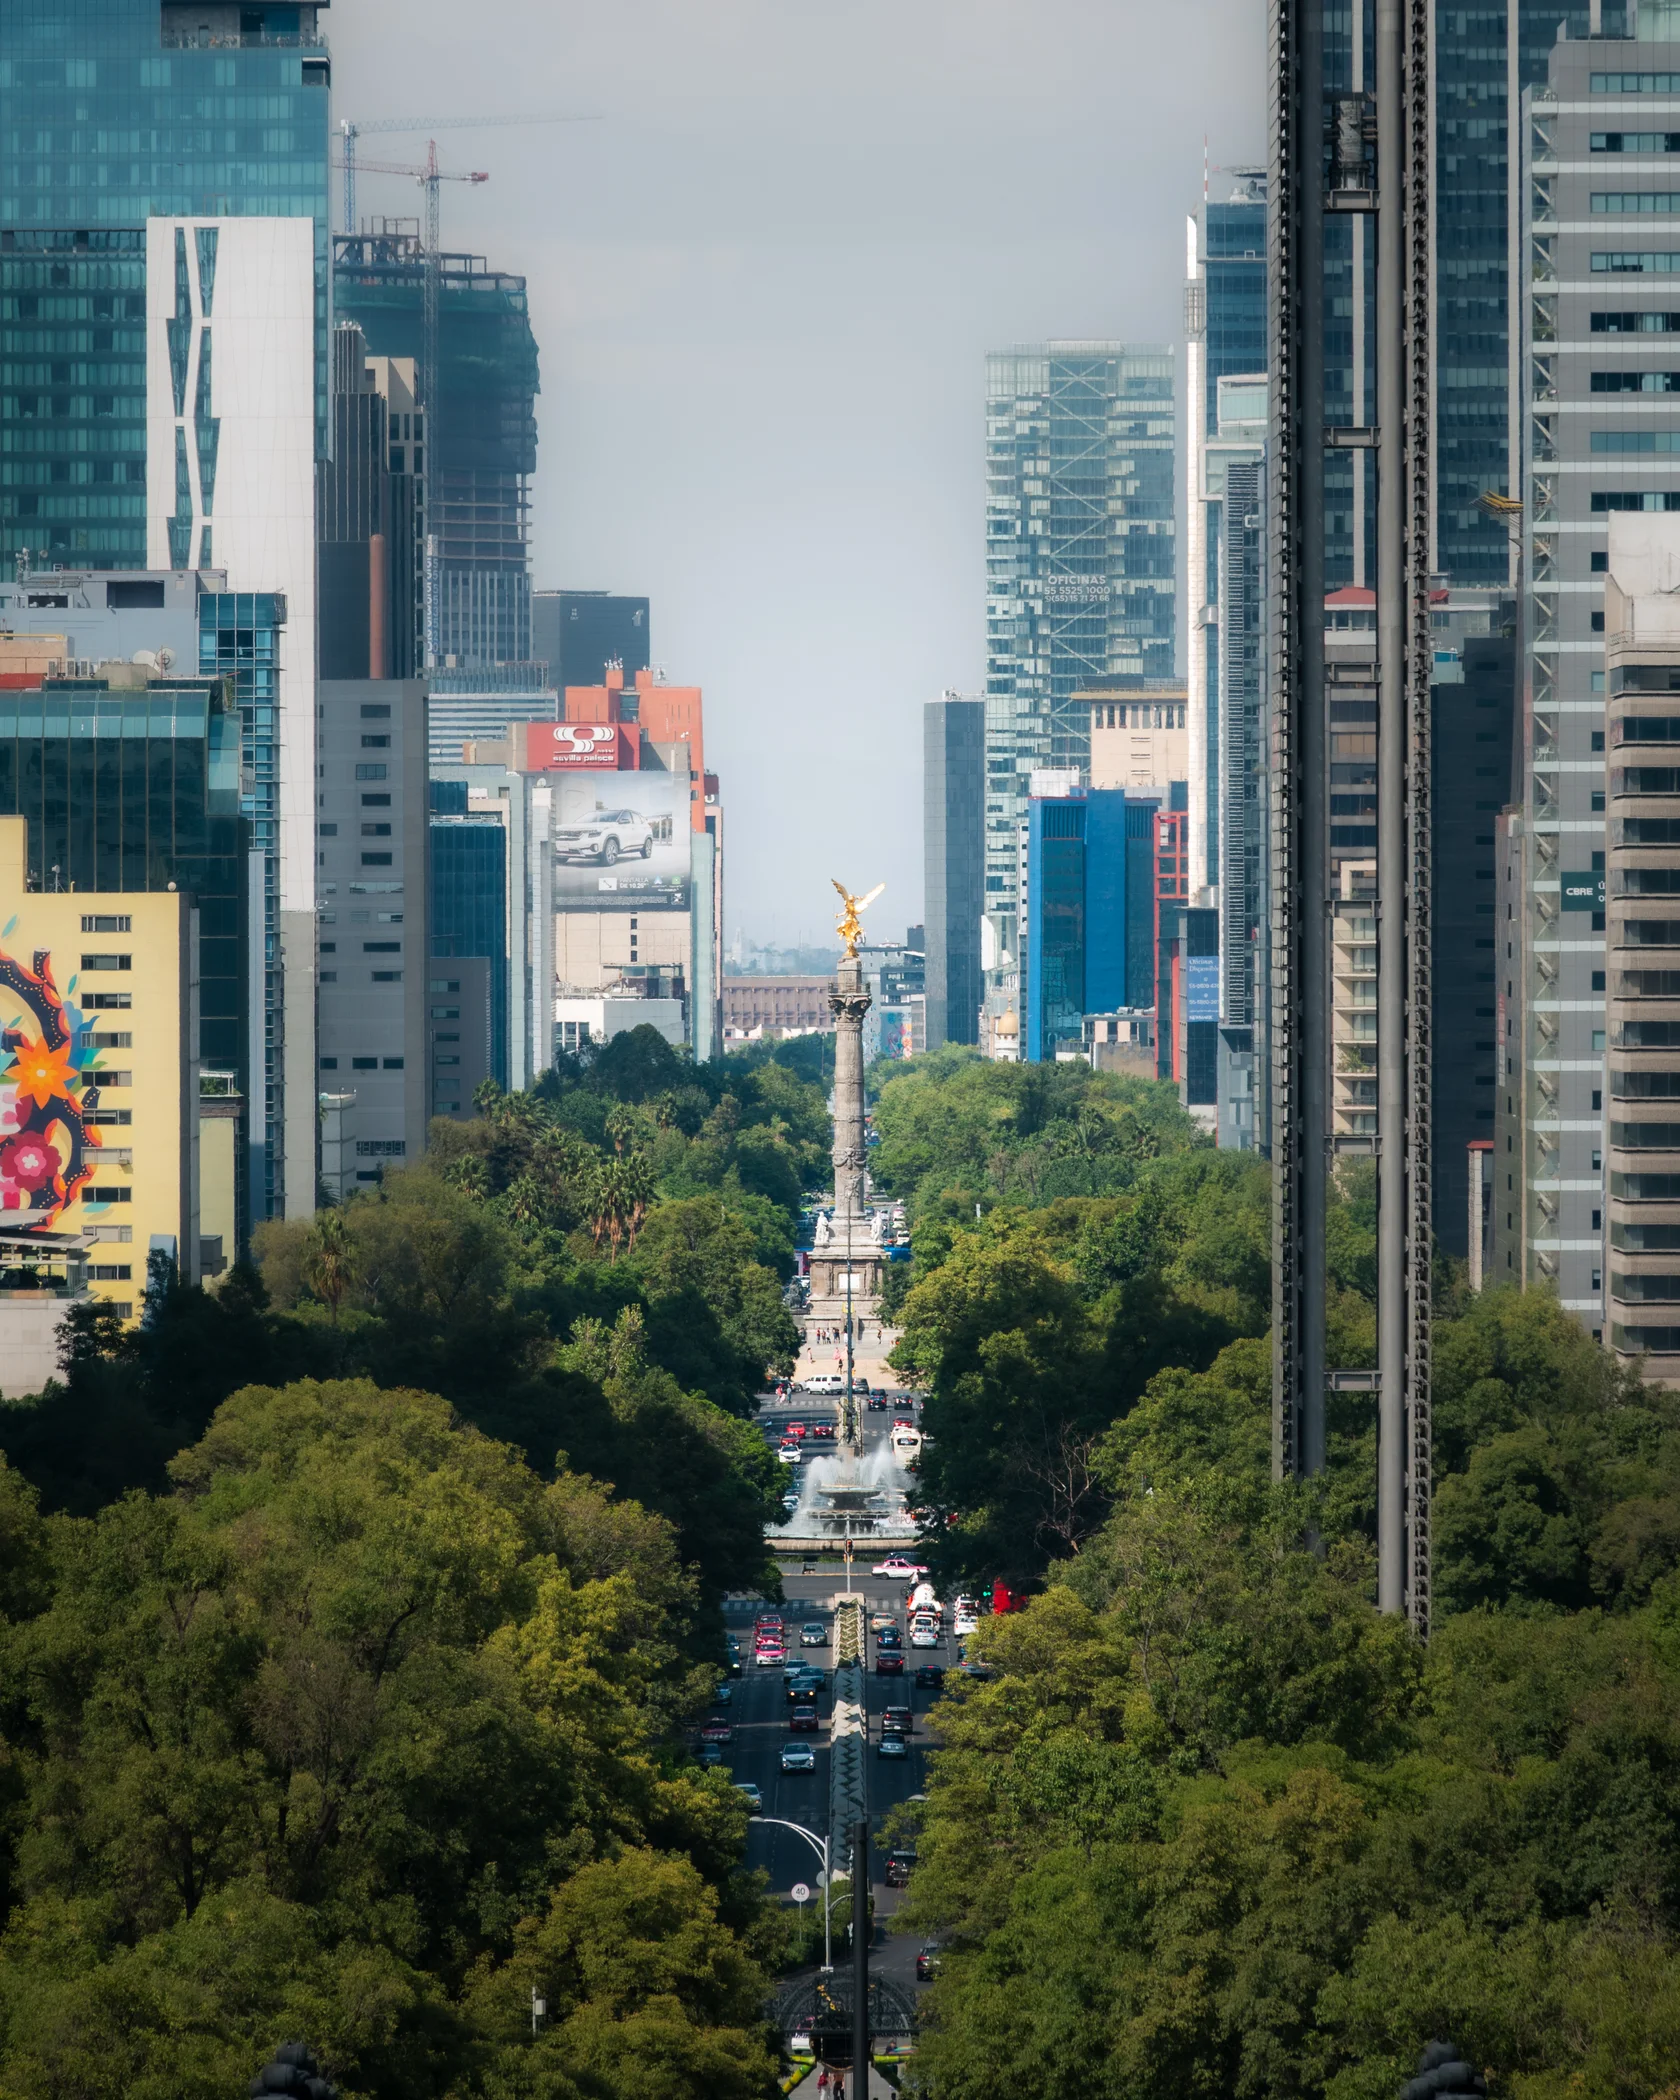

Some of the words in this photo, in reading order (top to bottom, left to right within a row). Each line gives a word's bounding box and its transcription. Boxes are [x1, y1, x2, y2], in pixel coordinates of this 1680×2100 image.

[1048, 575, 1107, 585] OFICINAS
[1044, 586, 1057, 595] 55
[1059, 586, 1083, 595] 5525
[1086, 586, 1111, 595] 1000
[1566, 887, 1594, 896] CBRE
[795, 1887, 806, 1896] 40
